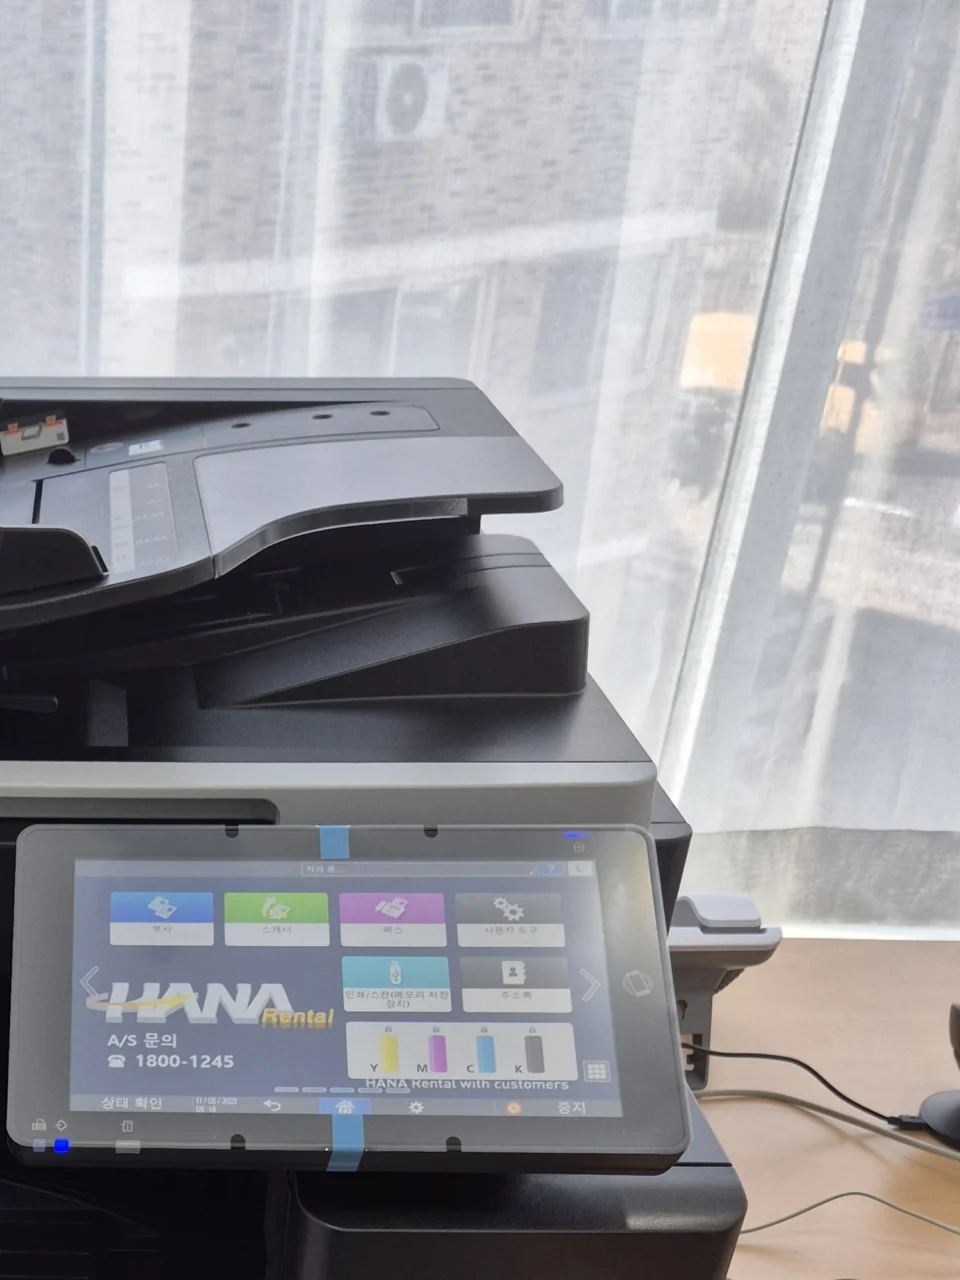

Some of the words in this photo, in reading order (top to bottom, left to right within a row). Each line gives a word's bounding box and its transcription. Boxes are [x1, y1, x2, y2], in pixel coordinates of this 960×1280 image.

[262, 924, 292, 934] 스캐너
[484, 925, 515, 935] 사용자
[518, 926, 538, 934] 도구
[105, 982, 294, 1024] HANA
[262, 1008, 335, 1030] Rental
[107, 1034, 138, 1048] A/S
[143, 1033, 177, 1049] 문의
[136, 1055, 234, 1069] 1800-1245
[370, 1064, 378, 1073] Y
[417, 1064, 428, 1073] M
[466, 1065, 475, 1074] C
[515, 1065, 523, 1074] K
[365, 1078, 408, 1089] HANA
[411, 1079, 457, 1090] Rental
[459, 1079, 490, 1090] with
[494, 1080, 569, 1090] customers
[101, 1097, 129, 1110] 상태
[135, 1097, 162, 1111] 확인
[557, 1102, 587, 1114] 중지
